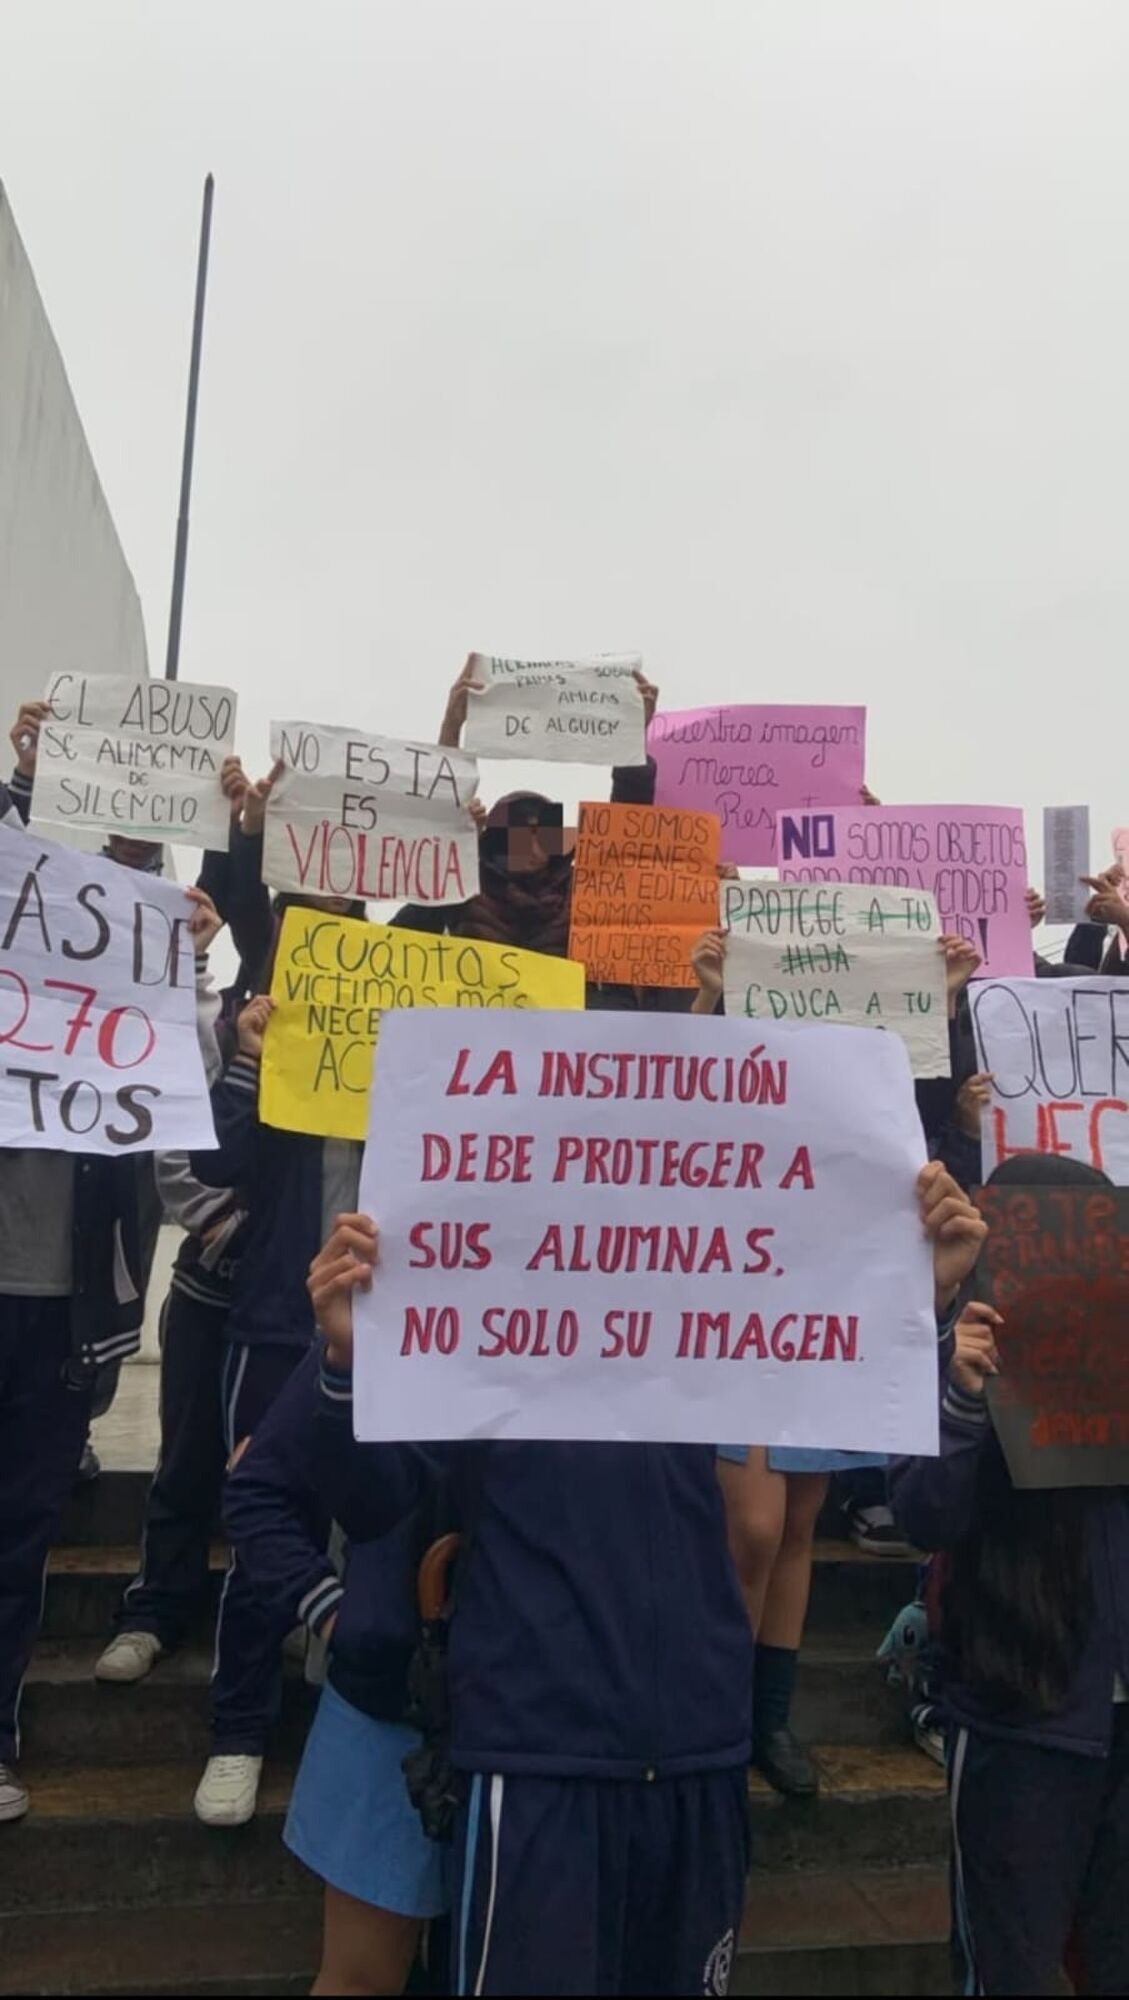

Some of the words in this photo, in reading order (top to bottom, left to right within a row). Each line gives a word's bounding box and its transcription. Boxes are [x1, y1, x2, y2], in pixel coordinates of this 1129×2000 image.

[48, 674, 93, 726] EL
[119, 684, 231, 741] ABUSO
[505, 715, 531, 736] DE
[545, 717, 620, 736] ALGUIEN
[44, 726, 78, 760] SE
[96, 738, 216, 772] ALIMENTA
[281, 730, 320, 772] NO
[346, 741, 390, 785] ES
[405, 747, 461, 808] IA
[759, 721, 860, 768] imagen
[56, 778, 198, 823] SILENCIO
[129, 771, 149, 786] DE
[341, 792, 377, 831] ES
[580, 808, 611, 836] NO
[623, 811, 708, 846] SOMOS
[286, 820, 466, 901] VIOLENCIA
[578, 839, 702, 874] IMAGENES
[782, 815, 835, 860] NO
[847, 821, 930, 863] SOMOS
[936, 821, 1026, 867] OBJETOS
[574, 868, 627, 898] PARA
[637, 873, 717, 903] EDITAR
[1, 853, 111, 961] ÁS
[132, 901, 194, 988] DE
[725, 886, 846, 937] PROTEGE
[868, 897, 884, 933] A
[901, 898, 931, 931] TU
[571, 931, 681, 963] MUJERES
[588, 962, 616, 982] ARA
[630, 962, 699, 987] RESPETA
[0, 969, 155, 1069] 270
[308, 1005, 380, 1036] NECE
[744, 984, 841, 1019] EDUCA
[866, 992, 881, 1015] A
[903, 992, 931, 1014] TU
[313, 1037, 377, 1093] AC
[974, 984, 1129, 1099] QUER
[446, 1048, 516, 1097] LA
[538, 1044, 787, 1105] INSTITUCIÓN
[6, 1067, 162, 1145] TOS
[992, 1098, 1129, 1170] HEC
[420, 1133, 535, 1183] DEBE
[552, 1136, 765, 1190] PROTEGER
[778, 1146, 815, 1190] A
[408, 1222, 492, 1269] SUS
[400, 1307, 460, 1357] NO
[478, 1308, 579, 1357] SOLO
[600, 1311, 652, 1359] SU
